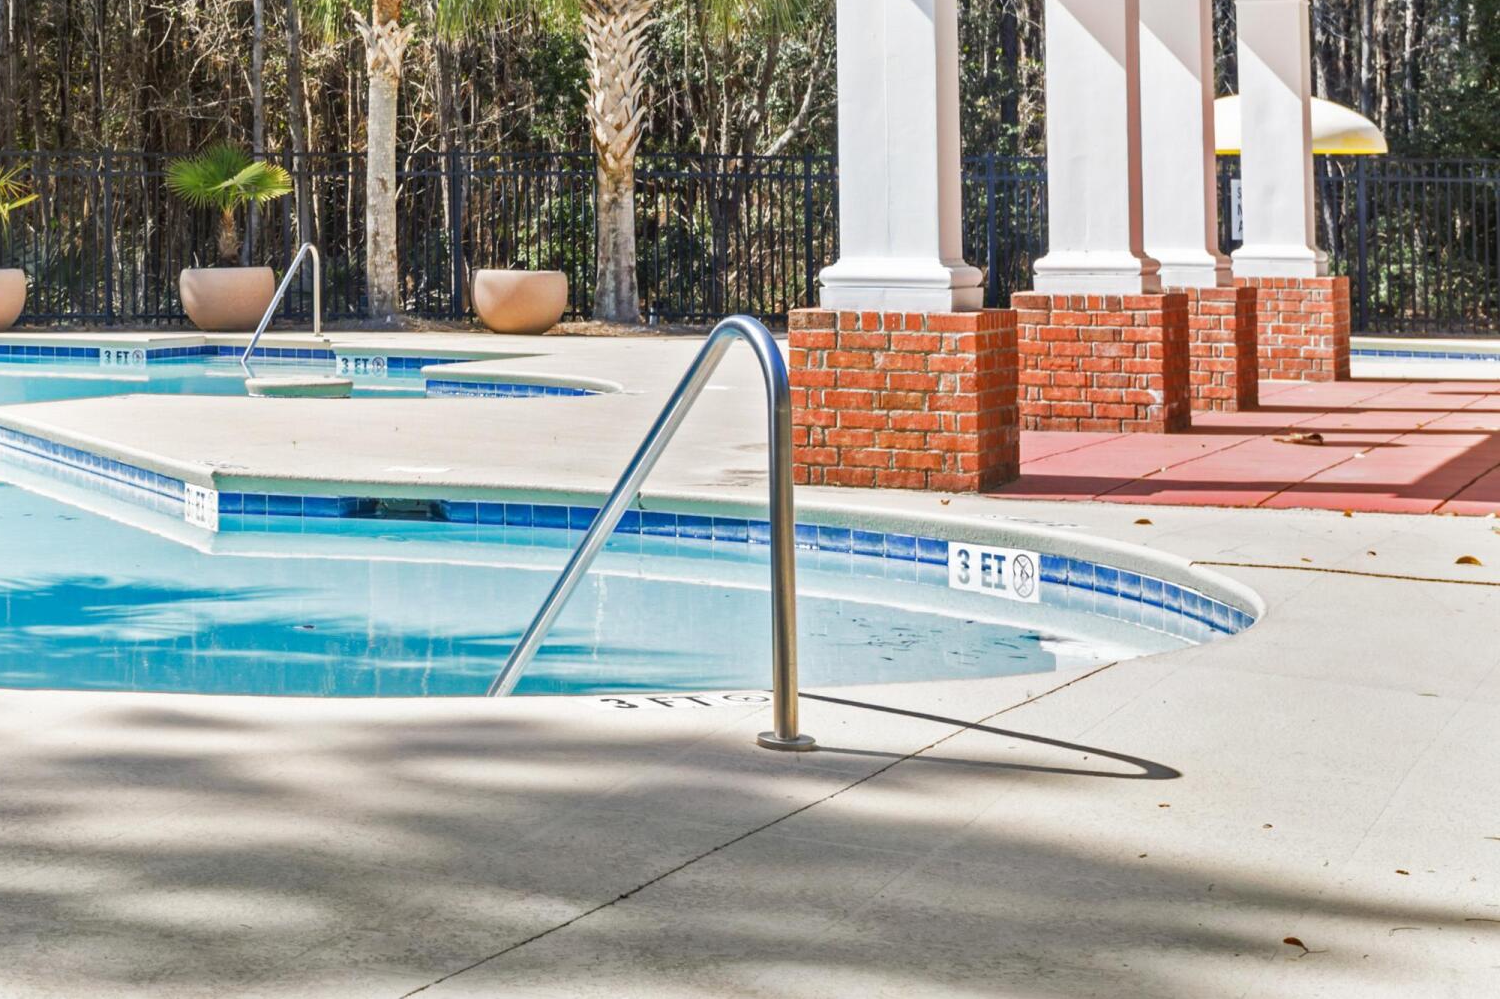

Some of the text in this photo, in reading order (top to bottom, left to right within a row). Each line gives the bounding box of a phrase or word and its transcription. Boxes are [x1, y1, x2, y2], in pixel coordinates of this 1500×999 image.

[116, 350, 130, 362] FT
[354, 357, 370, 371] FT
[957, 548, 970, 576] 3
[600, 695, 713, 709] 3 FT
